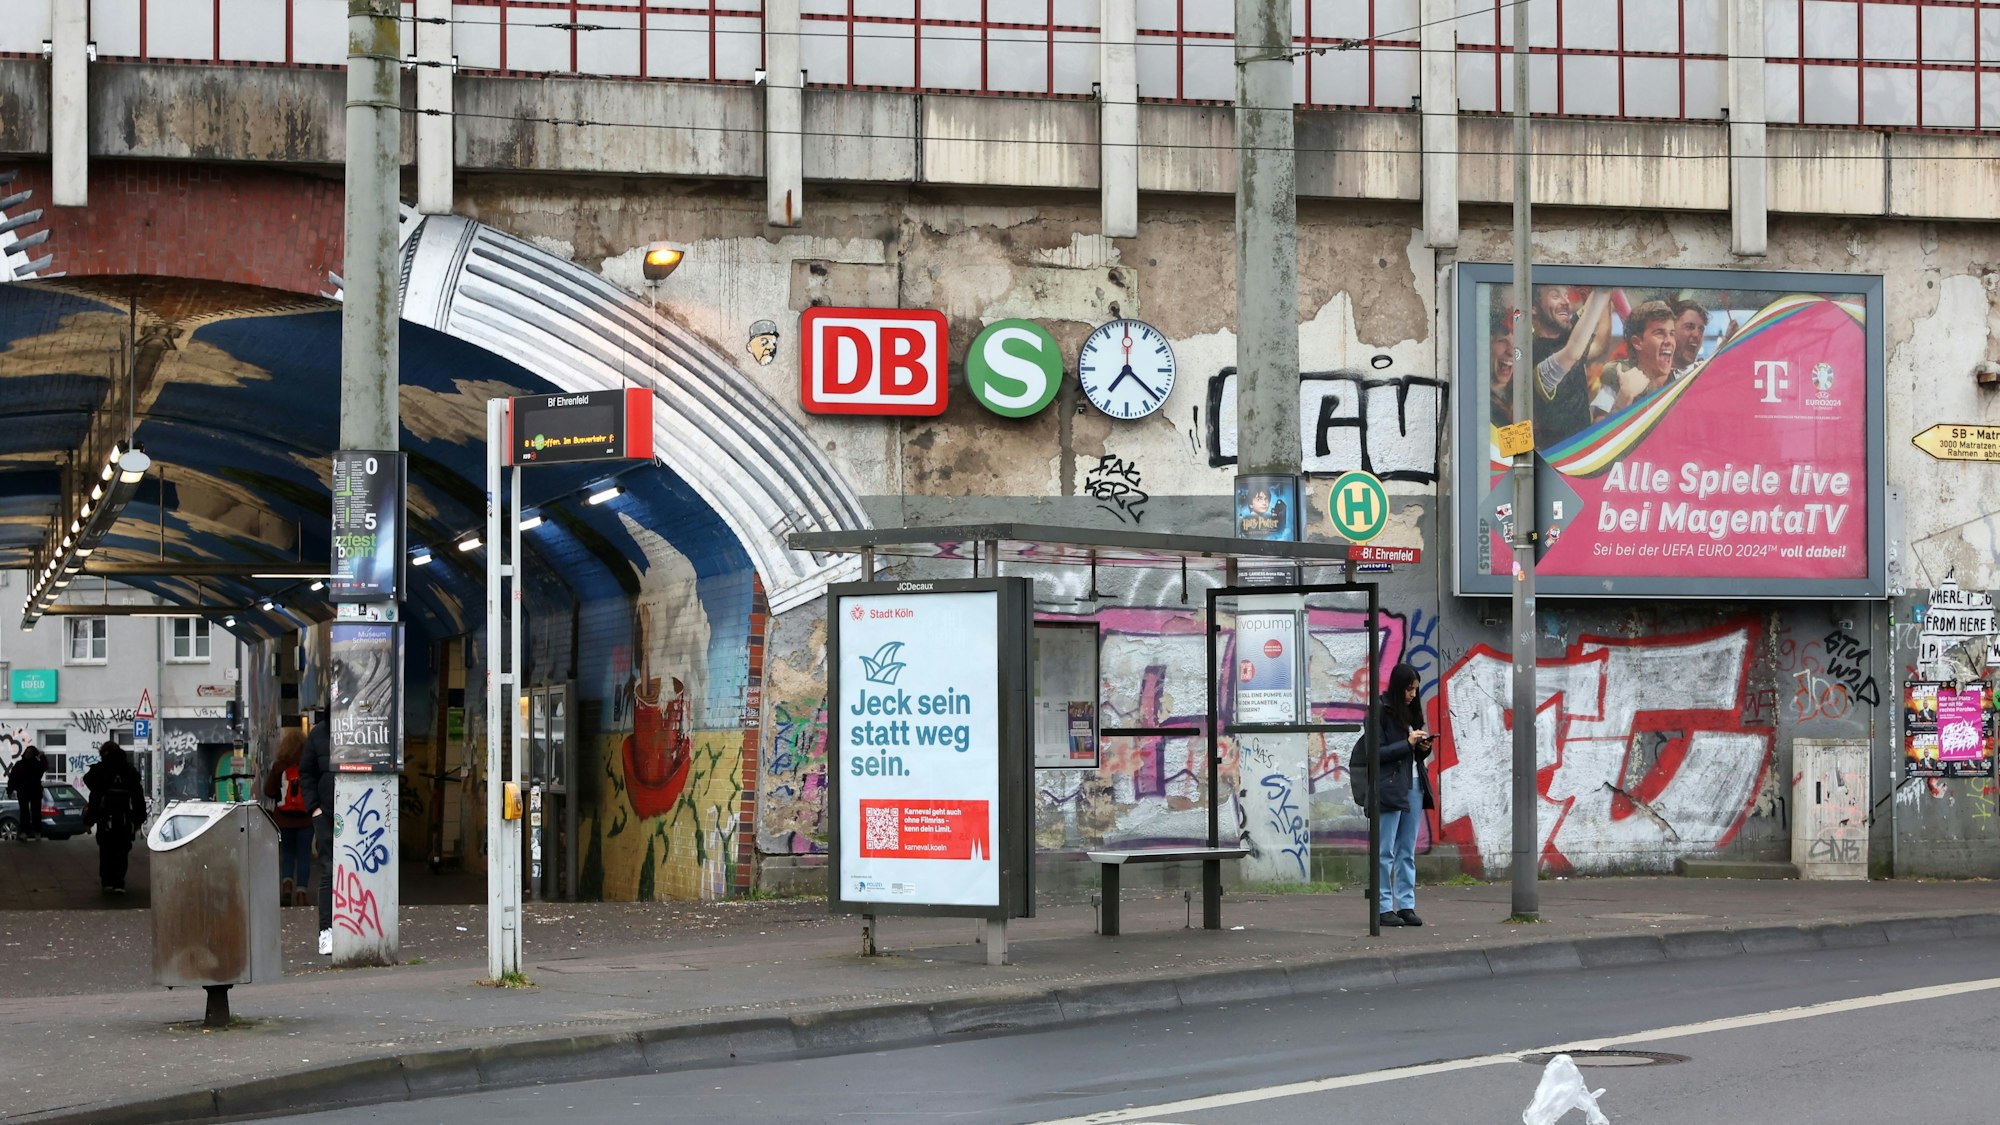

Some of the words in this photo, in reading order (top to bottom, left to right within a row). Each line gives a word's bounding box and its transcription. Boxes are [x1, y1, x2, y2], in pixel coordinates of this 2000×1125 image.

[823, 325, 928, 396] DB
[983, 327, 1047, 409] S
[1754, 361, 1787, 402] T
[548, 398, 556, 407] Bf
[557, 395, 589, 406] Ehrenfeld
[563, 437, 571, 445] Im
[573, 435, 606, 444] Busverkehr
[1952, 429, 1967, 438] SB
[1940, 440, 1957, 448] 3000
[1603, 461, 1670, 493] Alle
[1679, 462, 1780, 500] Spiele
[1790, 464, 1850, 495] live
[1344, 488, 1372, 526] H
[365, 513, 377, 530] 5
[1598, 501, 1652, 533] bei
[1658, 502, 1849, 540] MagentaTV
[1363, 547, 1374, 559] Bf.
[1375, 548, 1413, 562] Ehrenfeld
[1593, 543, 1612, 555] Sei
[1615, 544, 1635, 555] bei
[1639, 544, 1659, 556] der
[1662, 544, 1694, 556] UEFA
[1698, 544, 1733, 557] EURO
[1780, 546, 1802, 558] voll
[1805, 546, 1847, 558] dabei!
[897, 583, 933, 592] JCDecaux
[870, 609, 893, 619] Stadt
[895, 608, 913, 618] Köln
[1926, 616, 1956, 631] FROM
[1960, 617, 1986, 632] HERE
[851, 688, 912, 716] Jeck
[918, 687, 971, 715] sein
[851, 721, 910, 746] statt
[916, 724, 970, 752] weg
[851, 748, 910, 776] sein.
[932, 808, 946, 816] geht
